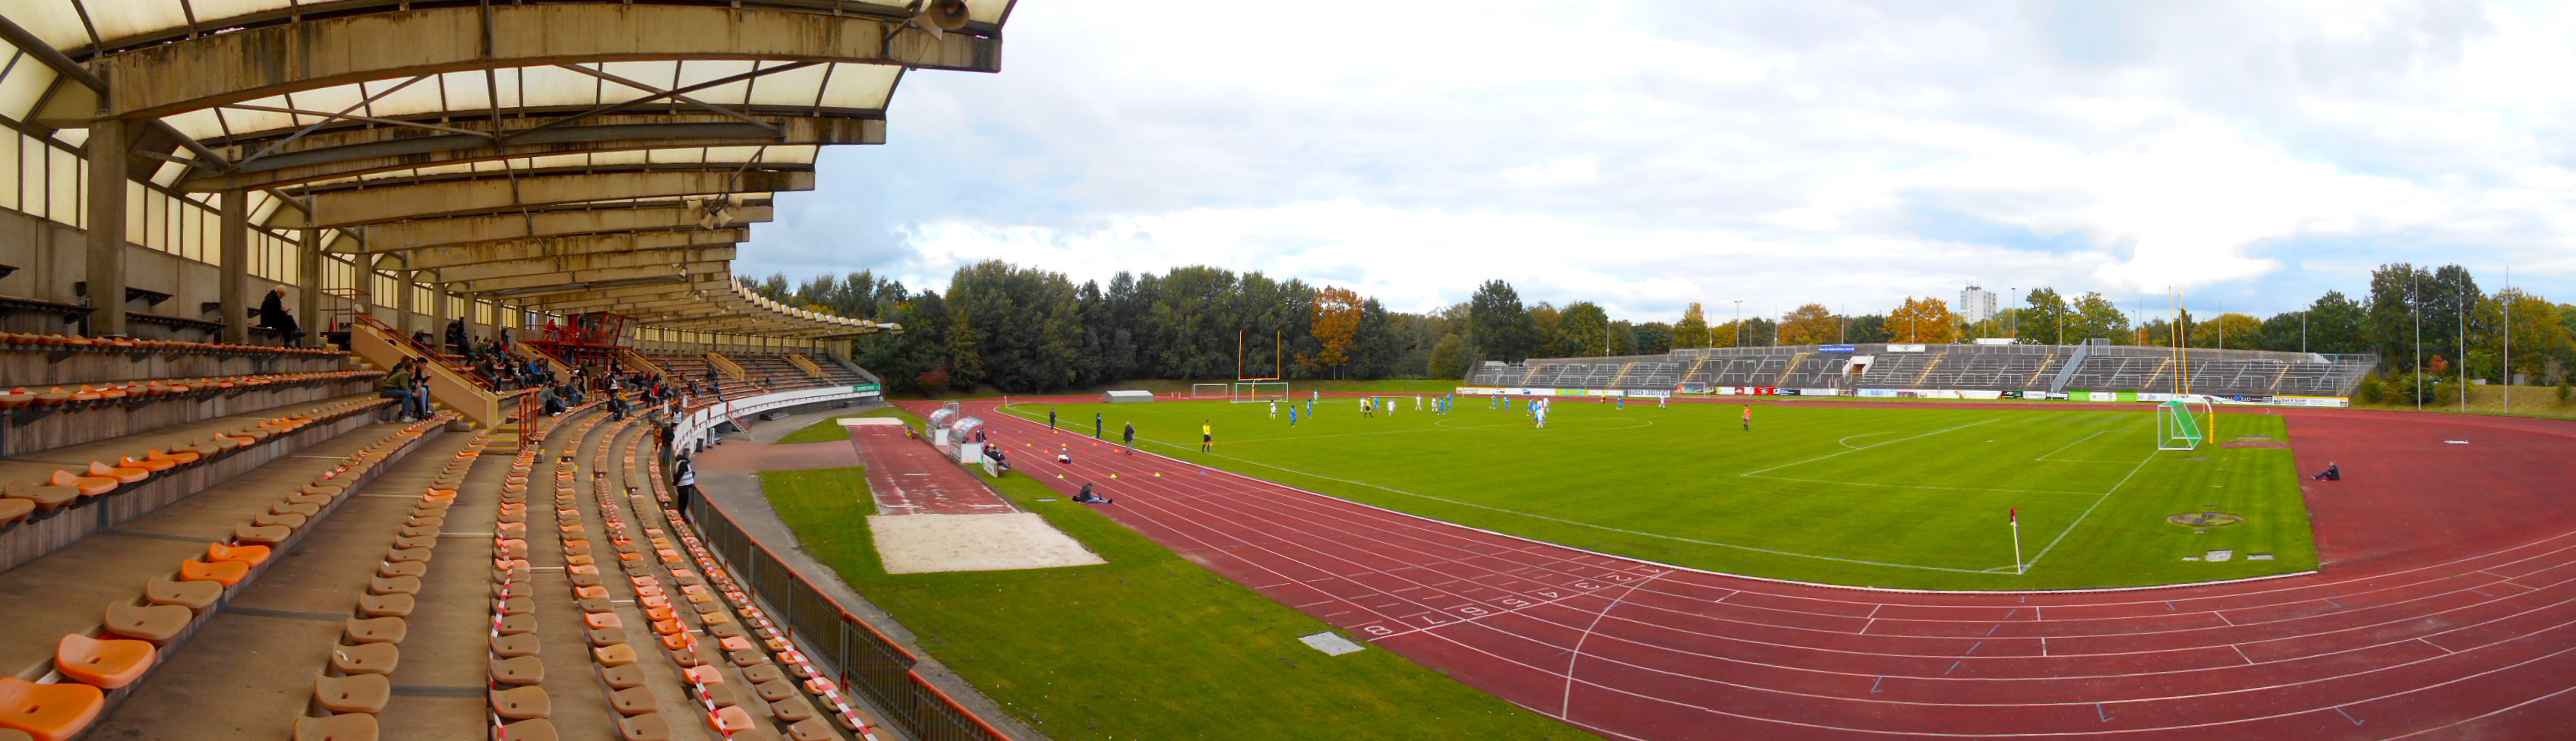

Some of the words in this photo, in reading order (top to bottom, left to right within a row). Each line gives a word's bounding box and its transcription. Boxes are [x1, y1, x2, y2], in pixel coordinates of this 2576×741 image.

[1502, 598, 1531, 607] 5
[1460, 607, 1488, 616] 6
[1422, 616, 1446, 625] 7
[1364, 626, 1393, 635] 8
